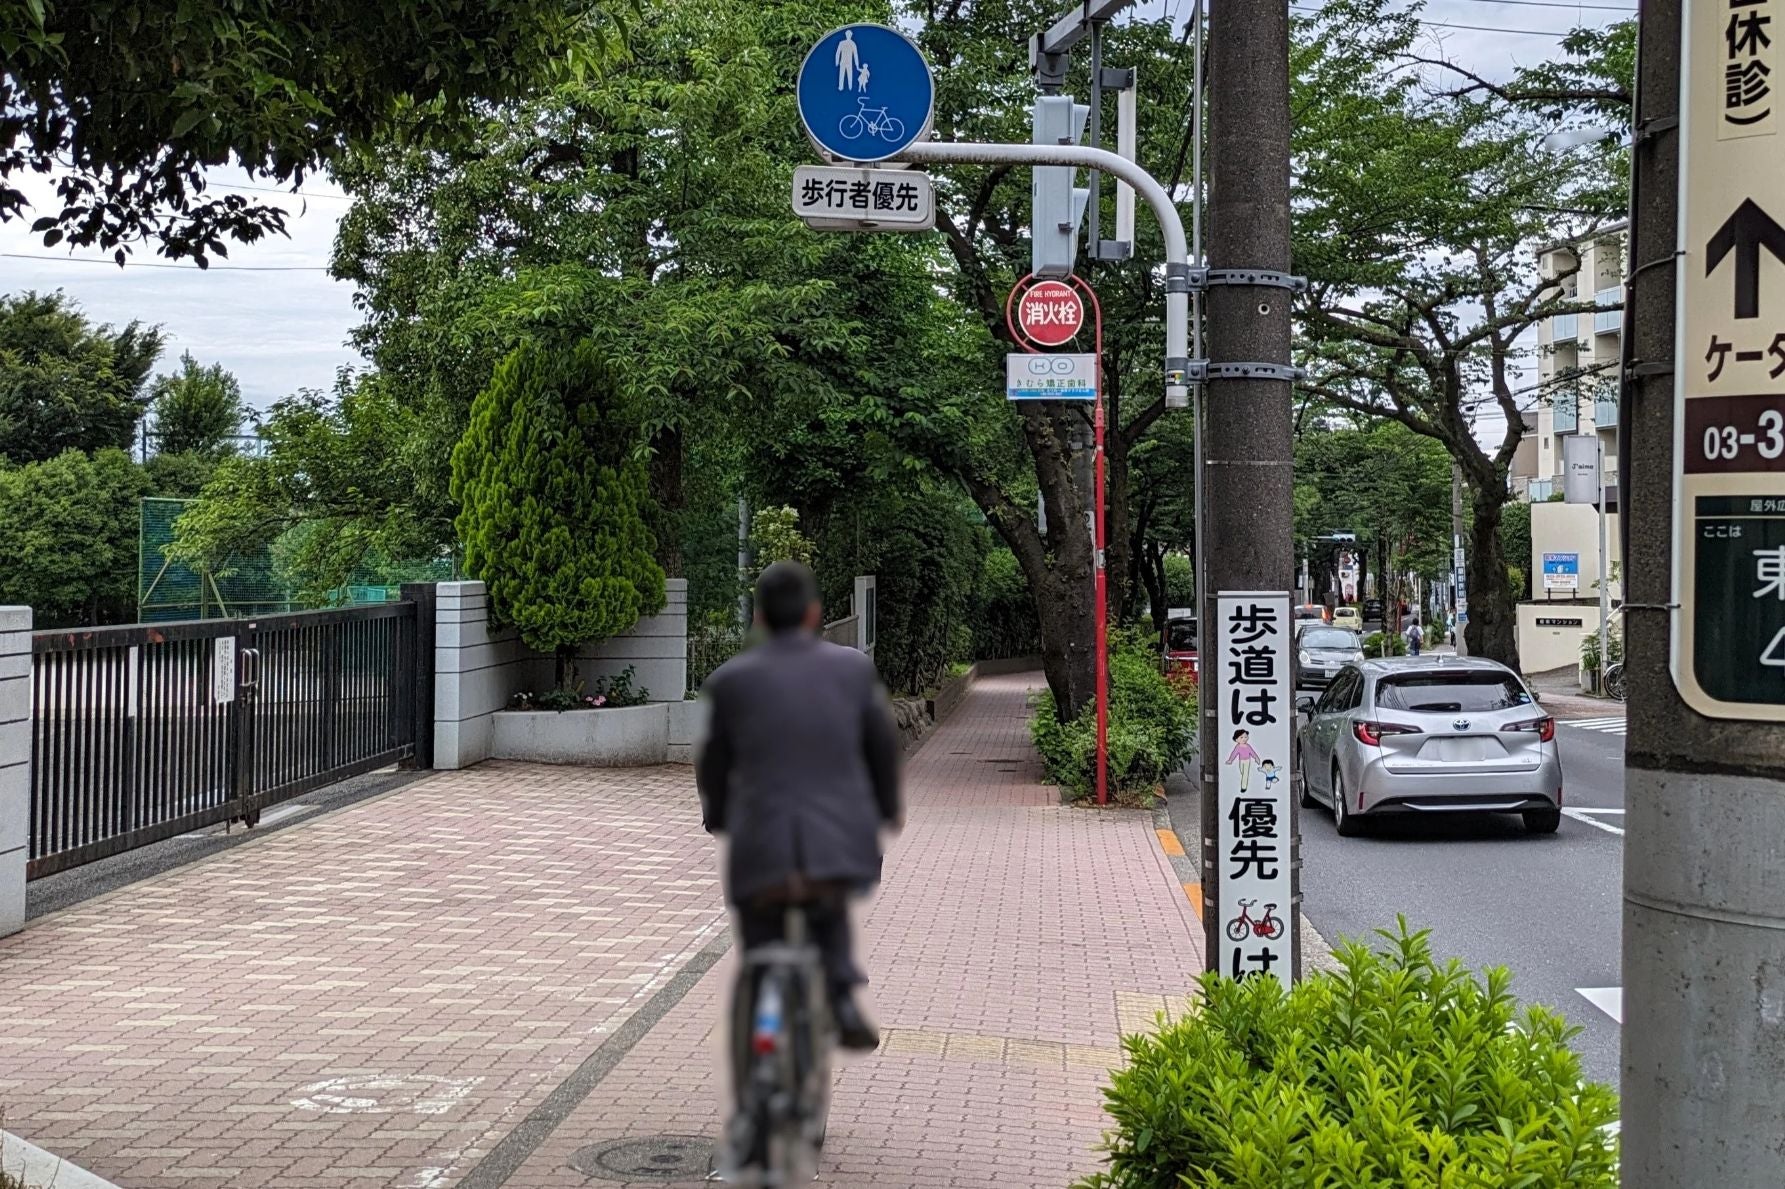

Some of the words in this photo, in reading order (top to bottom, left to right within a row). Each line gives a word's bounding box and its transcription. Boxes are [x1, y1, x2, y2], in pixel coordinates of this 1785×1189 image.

[802, 178, 918, 211] 歩行者優先
[1026, 301, 1077, 325] 消火栓
[1704, 410, 1784, 460] 03-3
[1704, 526, 1742, 538] ここは
[1228, 604, 1278, 726] 歩道は
[1228, 797, 1278, 880] 優先
